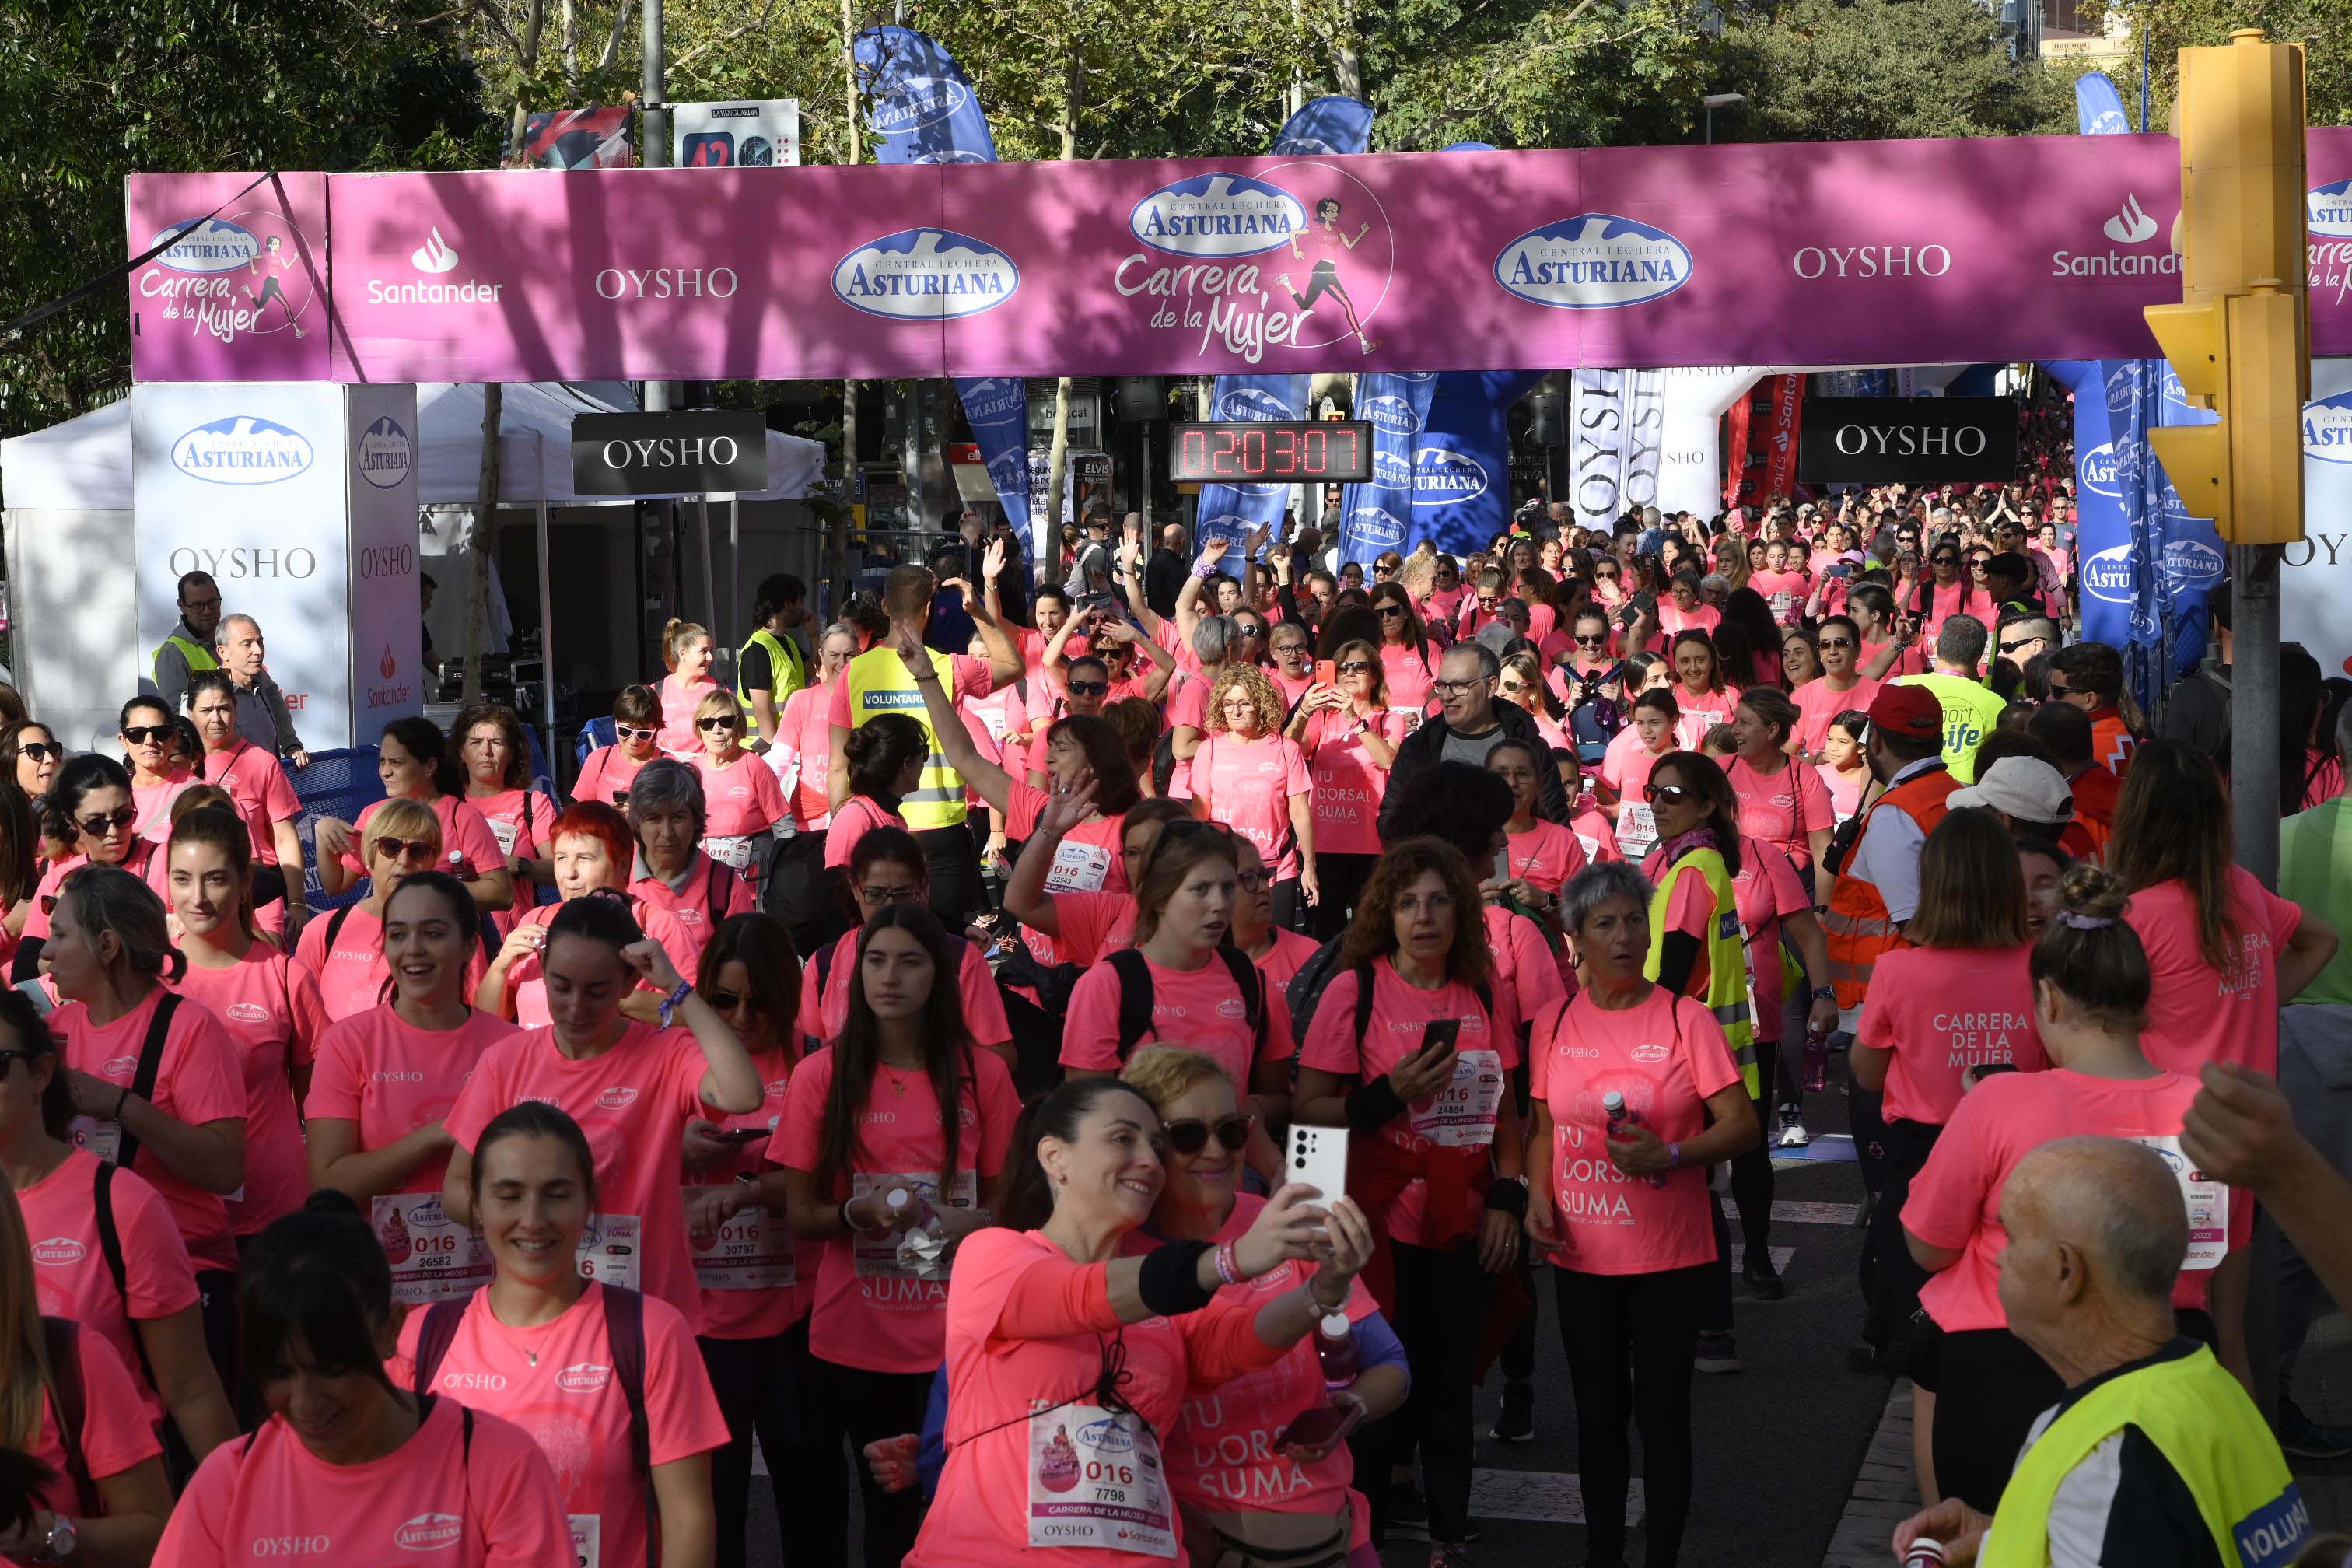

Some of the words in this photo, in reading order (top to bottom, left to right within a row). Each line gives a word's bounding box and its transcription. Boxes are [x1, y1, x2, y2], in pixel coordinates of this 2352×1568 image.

[1170, 201, 1227, 212] CENTRAL
[1230, 201, 1286, 211] LECHERA
[1143, 205, 1291, 237] ASTURIANA
[159, 237, 251, 259] ASTURIANA
[1540, 245, 1602, 257] CENTRAL
[1608, 245, 1671, 255] LECHERA
[875, 260, 933, 269] CENTRAL
[940, 258, 998, 268] LECHERA
[1509, 250, 1677, 285] ASTURIANA
[1793, 245, 1951, 278] OYSHO
[2053, 248, 2183, 276] Santand
[140, 268, 231, 299] Carrera
[595, 267, 738, 299] OYSHO
[846, 262, 1005, 296] ASTURIANA
[1115, 253, 1261, 297] Carrera
[2325, 264, 2340, 287] la
[368, 278, 504, 304] Santander
[162, 299, 180, 320] de
[183, 298, 194, 320] la
[193, 296, 265, 344] Mujer
[1150, 299, 1178, 329] de
[1183, 298, 1202, 329] la
[1199, 293, 1315, 364] Mujer
[1578, 369, 1619, 516] OYSH
[1626, 369, 1663, 507] OYSH
[1836, 425, 1986, 457] OYSHO
[183, 441, 303, 467] ASTURIANA
[362, 443, 408, 471] ASTURIANA
[604, 436, 738, 470] OYSHO
[1183, 430, 1356, 474] 02:03:07
[1657, 450, 1705, 466] YSHO
[1085, 464, 1108, 474] ELVIS
[1373, 466, 1412, 485] TURIANA
[1346, 522, 1401, 541] ASTURIANA
[169, 547, 316, 579] OYSHO
[360, 544, 412, 579] OYSHO
[367, 684, 411, 709] Santander
[1942, 723, 1980, 754] ife
[1318, 770, 1332, 782] TU
[1318, 788, 1370, 803] DORSAL
[1735, 790, 1751, 800] SHO
[1219, 808, 1232, 822] TU
[1318, 805, 1357, 819] SUMA
[1636, 824, 1655, 833] 016
[1052, 876, 1072, 885] 22543
[1054, 865, 1080, 877] 016
[333, 950, 373, 961] OYSHO
[2217, 970, 2263, 996] MUJER
[230, 1009, 266, 1020] ASTURIANA
[1933, 1013, 2029, 1031] CARRERA
[1952, 1032, 1978, 1049] DE
[1986, 1031, 2011, 1048] LA
[1560, 1045, 1600, 1059] OYSHO
[1948, 1049, 2014, 1068] MUJER
[373, 1071, 423, 1083] OYSHO
[1437, 1104, 1465, 1115] 24854
[1558, 1125, 1583, 1149] TU
[1561, 1189, 1632, 1216] SUMA
[412, 1213, 447, 1223] ASTURIA
[720, 1224, 760, 1241] 016
[2193, 1231, 2212, 1240] 2023
[35, 1246, 82, 1259] ASTURIANA
[415, 1235, 457, 1253] 016
[725, 1244, 755, 1255] 30797
[418, 1255, 451, 1268] 26582
[393, 1272, 421, 1281] ARRERA
[860, 1277, 947, 1302] SUMA
[443, 1373, 507, 1391] OYSHO
[1082, 1430, 1132, 1447] ASTURIANA
[1086, 1461, 1133, 1485] 016
[1198, 1462, 1314, 1500] SUMA
[1094, 1486, 1125, 1503] 7798
[1048, 1506, 1092, 1514] CARRERA
[398, 1525, 462, 1544] ASTURIANA
[1044, 1524, 1094, 1538] OYSHO
[1129, 1530, 1167, 1546] Santander
[253, 1534, 330, 1557] OYSHO
